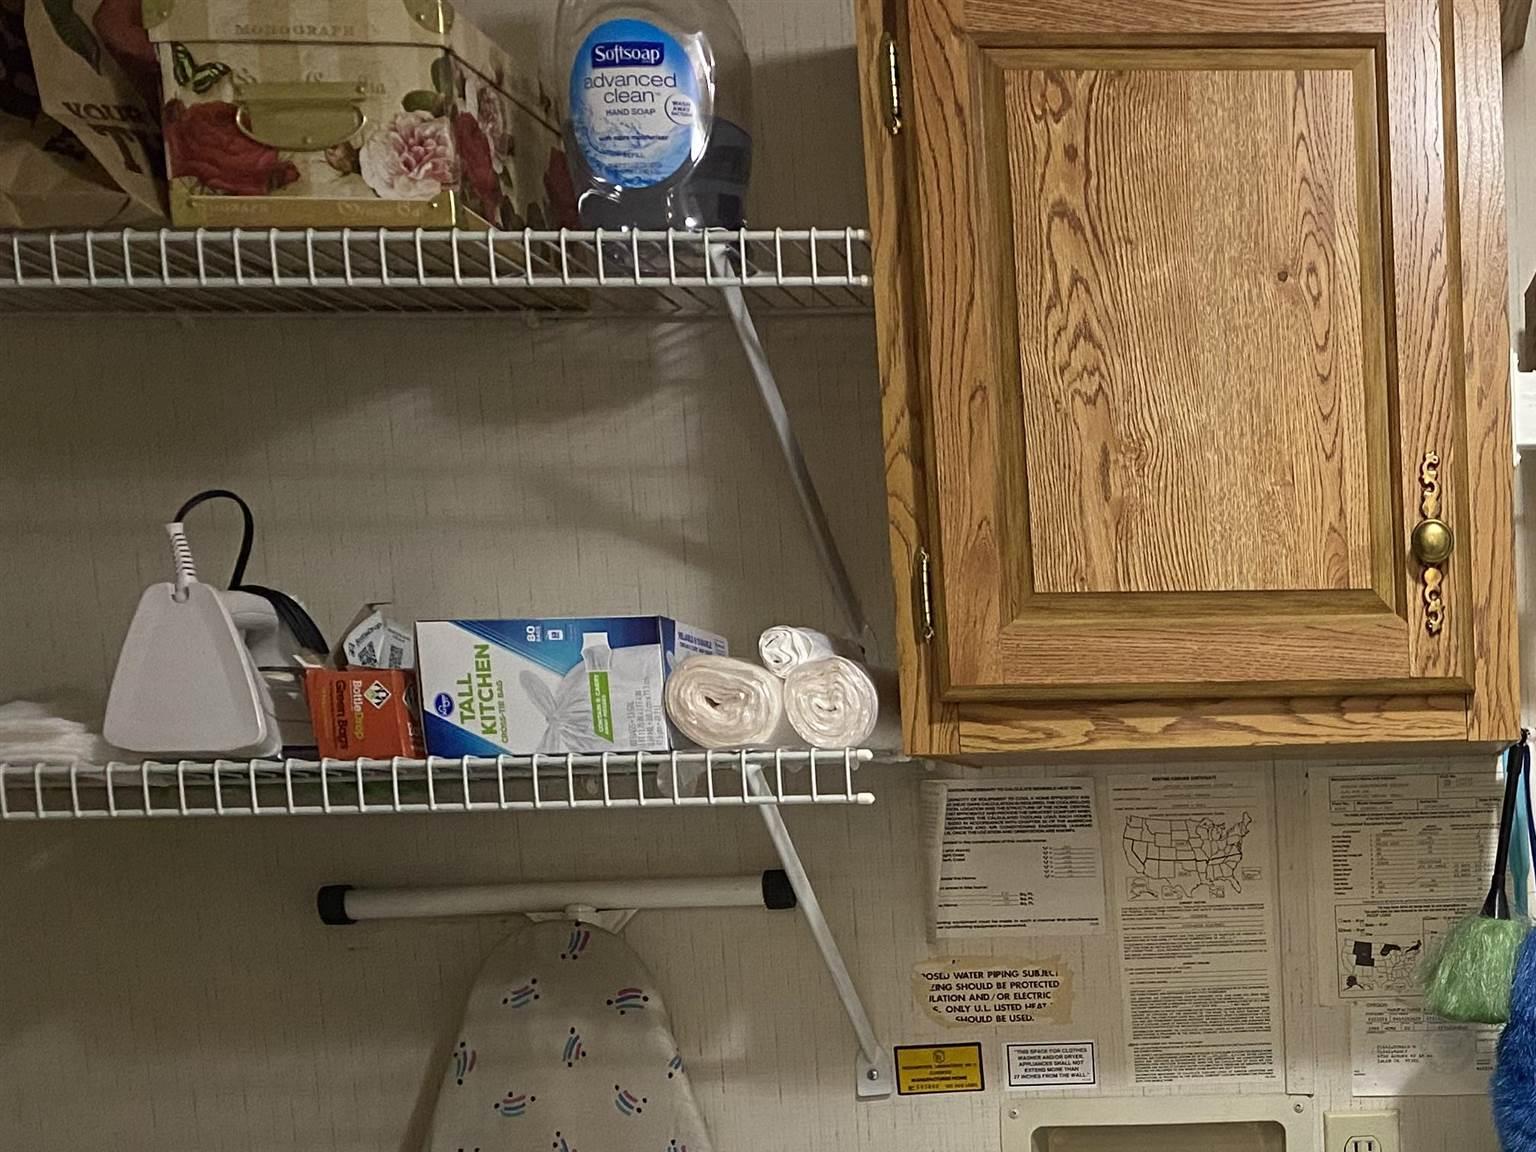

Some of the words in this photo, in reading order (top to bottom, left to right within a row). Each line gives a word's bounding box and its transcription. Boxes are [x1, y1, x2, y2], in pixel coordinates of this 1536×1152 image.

[594, 45, 660, 64] Softsoap
[584, 72, 677, 89] advanced
[604, 88, 655, 103] clean
[606, 108, 630, 116] HAND
[474, 644, 498, 735] KITCHEN
[456, 673, 475, 724] TALL
[953, 971, 984, 980] WATER
[987, 970, 1020, 979] PIPING
[956, 982, 994, 991] SHOULD
[1010, 981, 1060, 989] PROTECTED
[1014, 992, 1051, 1000] ELECTRIC
[945, 1005, 971, 1013] ONLY
[974, 1004, 991, 1012] U.L.
[956, 1015, 993, 1023] SHOULD
[1009, 1014, 1035, 1022] USED.
